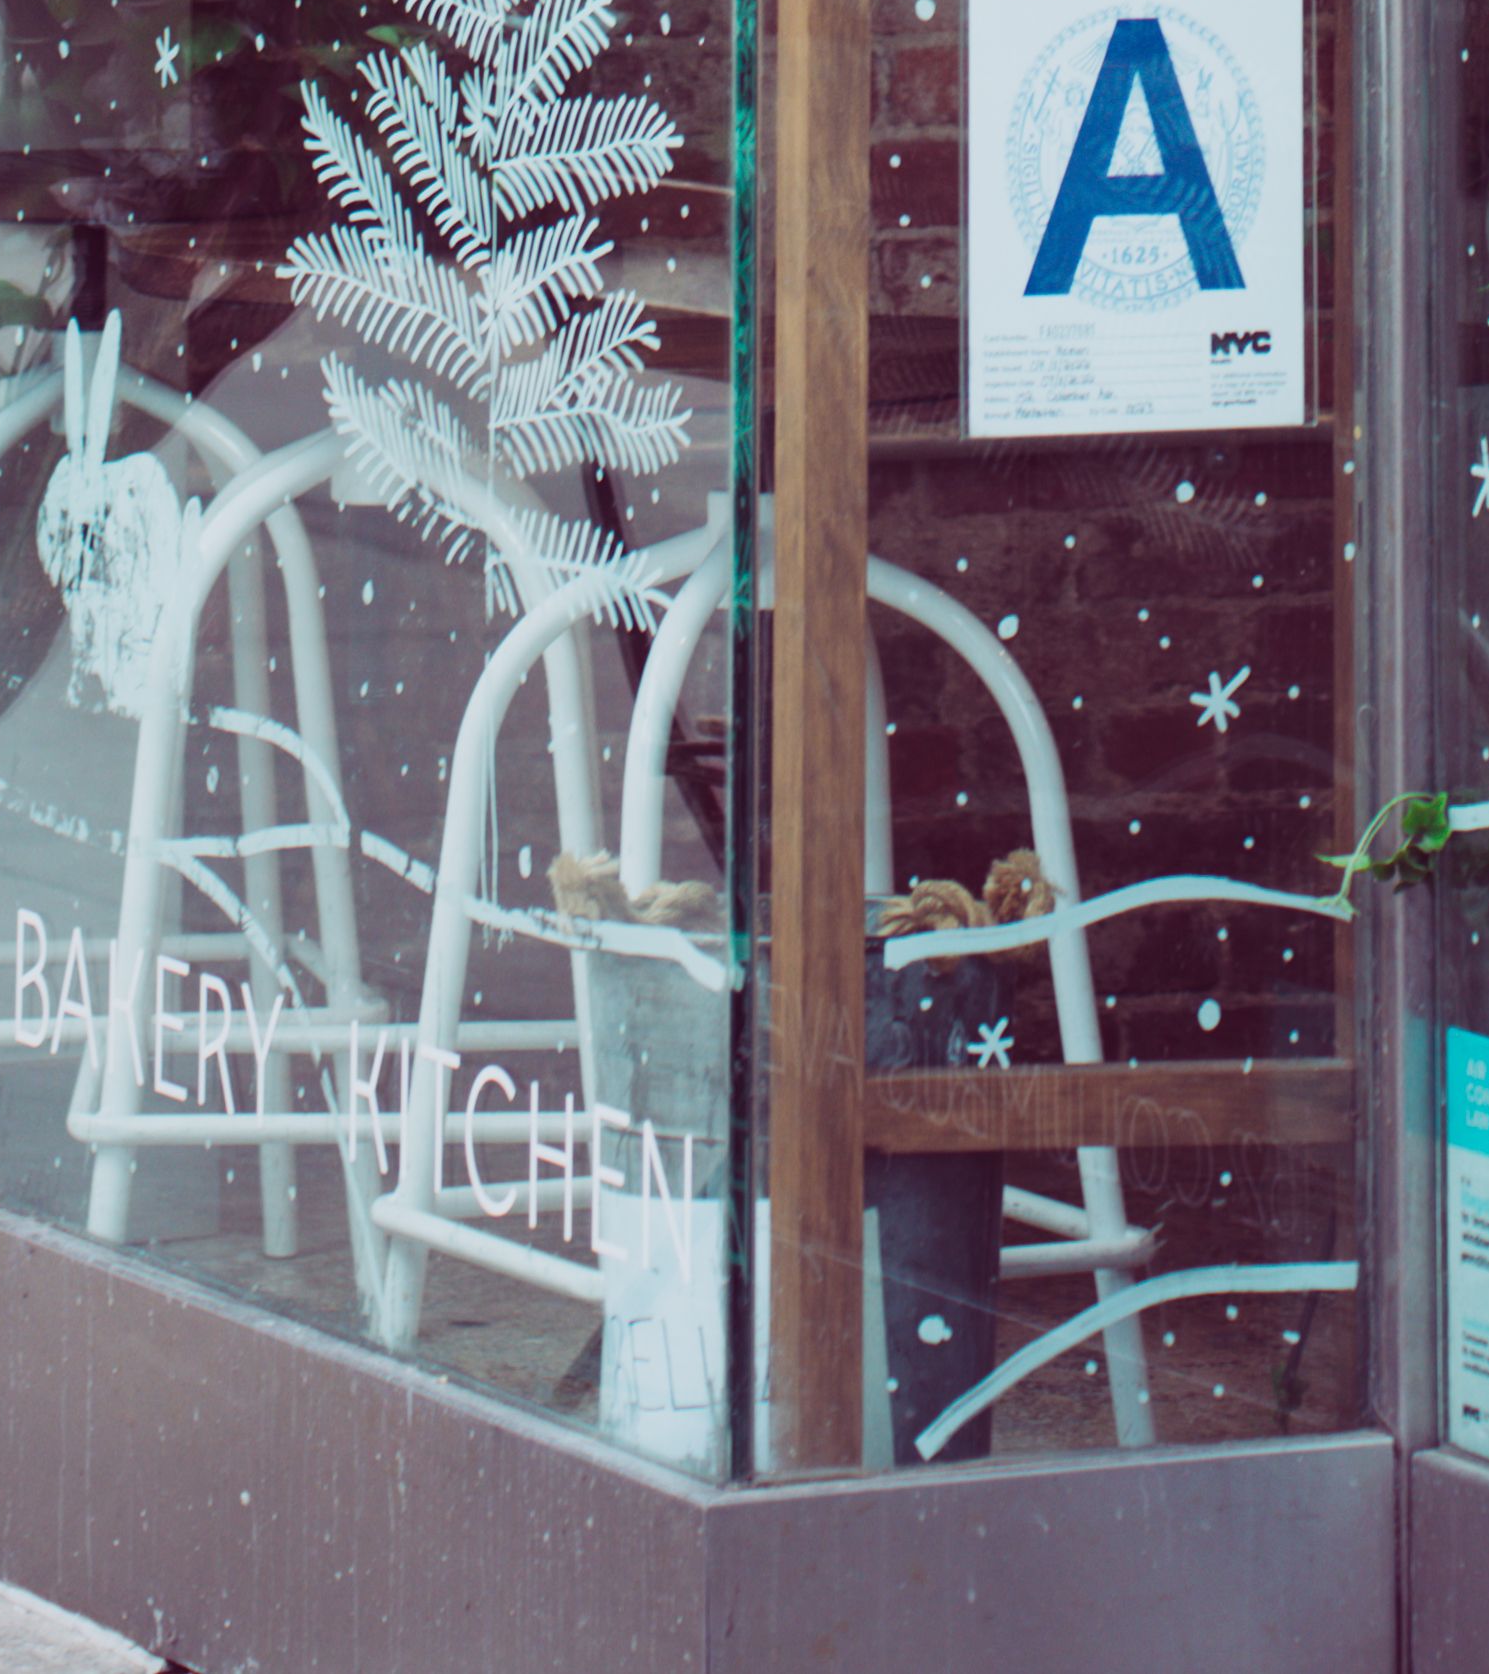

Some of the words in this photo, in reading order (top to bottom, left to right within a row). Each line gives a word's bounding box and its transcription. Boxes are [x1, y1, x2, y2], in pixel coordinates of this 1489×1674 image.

[1023, 18, 1246, 296] A
[1210, 331, 1271, 355] NYC
[15, 908, 285, 1126] BAKERY
[349, 1020, 693, 1283] KITCHEN
